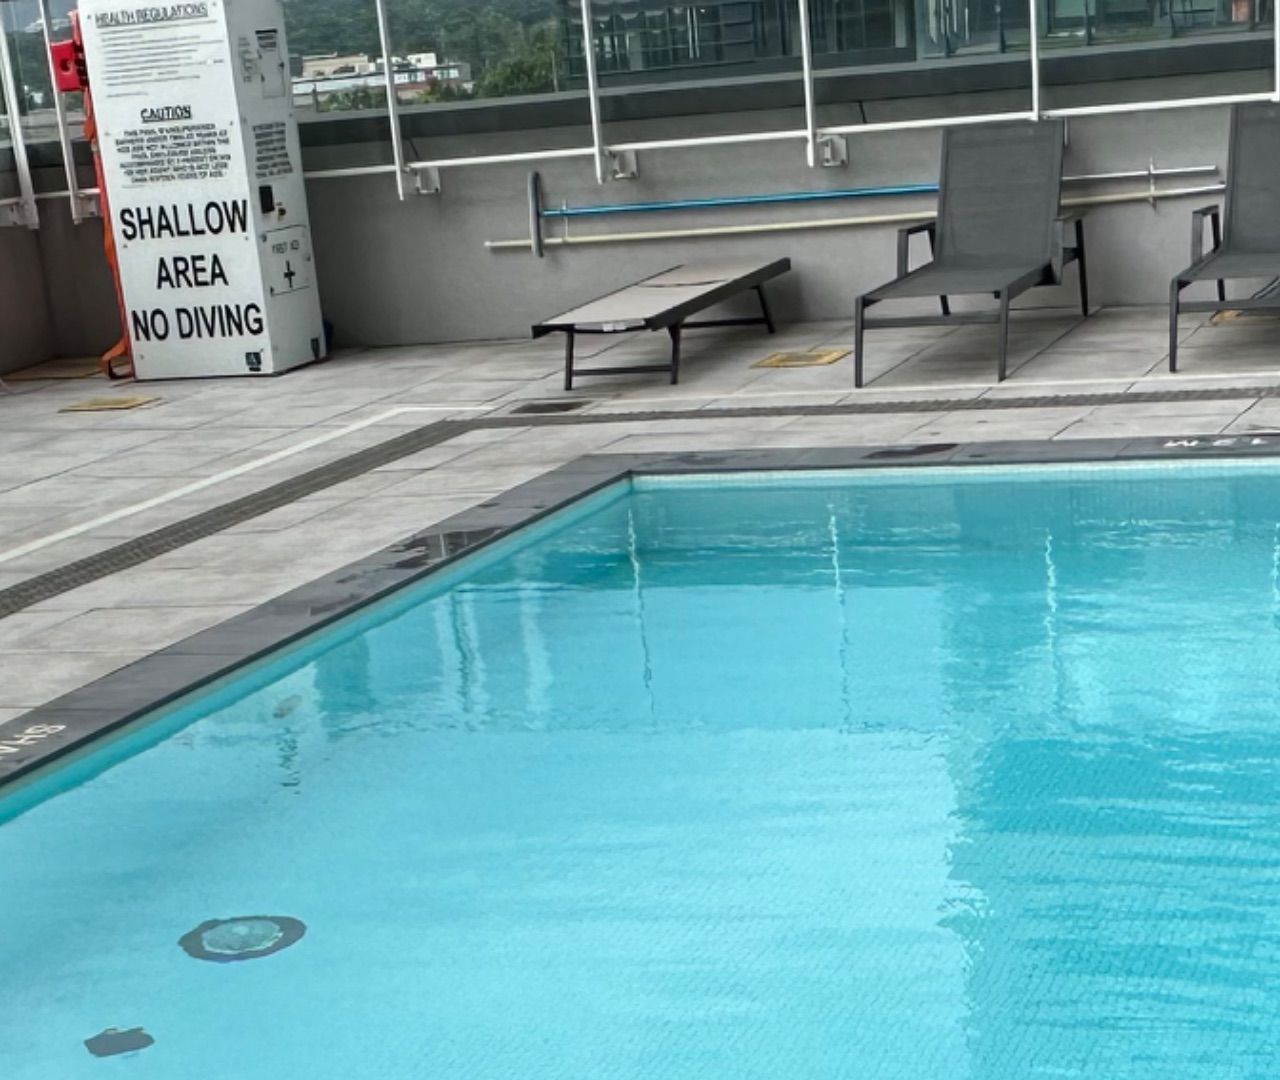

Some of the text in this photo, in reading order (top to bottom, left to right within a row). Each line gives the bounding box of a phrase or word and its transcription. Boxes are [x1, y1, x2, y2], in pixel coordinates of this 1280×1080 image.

[140, 104, 192, 122] CAUTION
[120, 199, 247, 241] SHALLOW
[157, 253, 229, 290] AREA
[132, 302, 264, 342] NO DIVING
